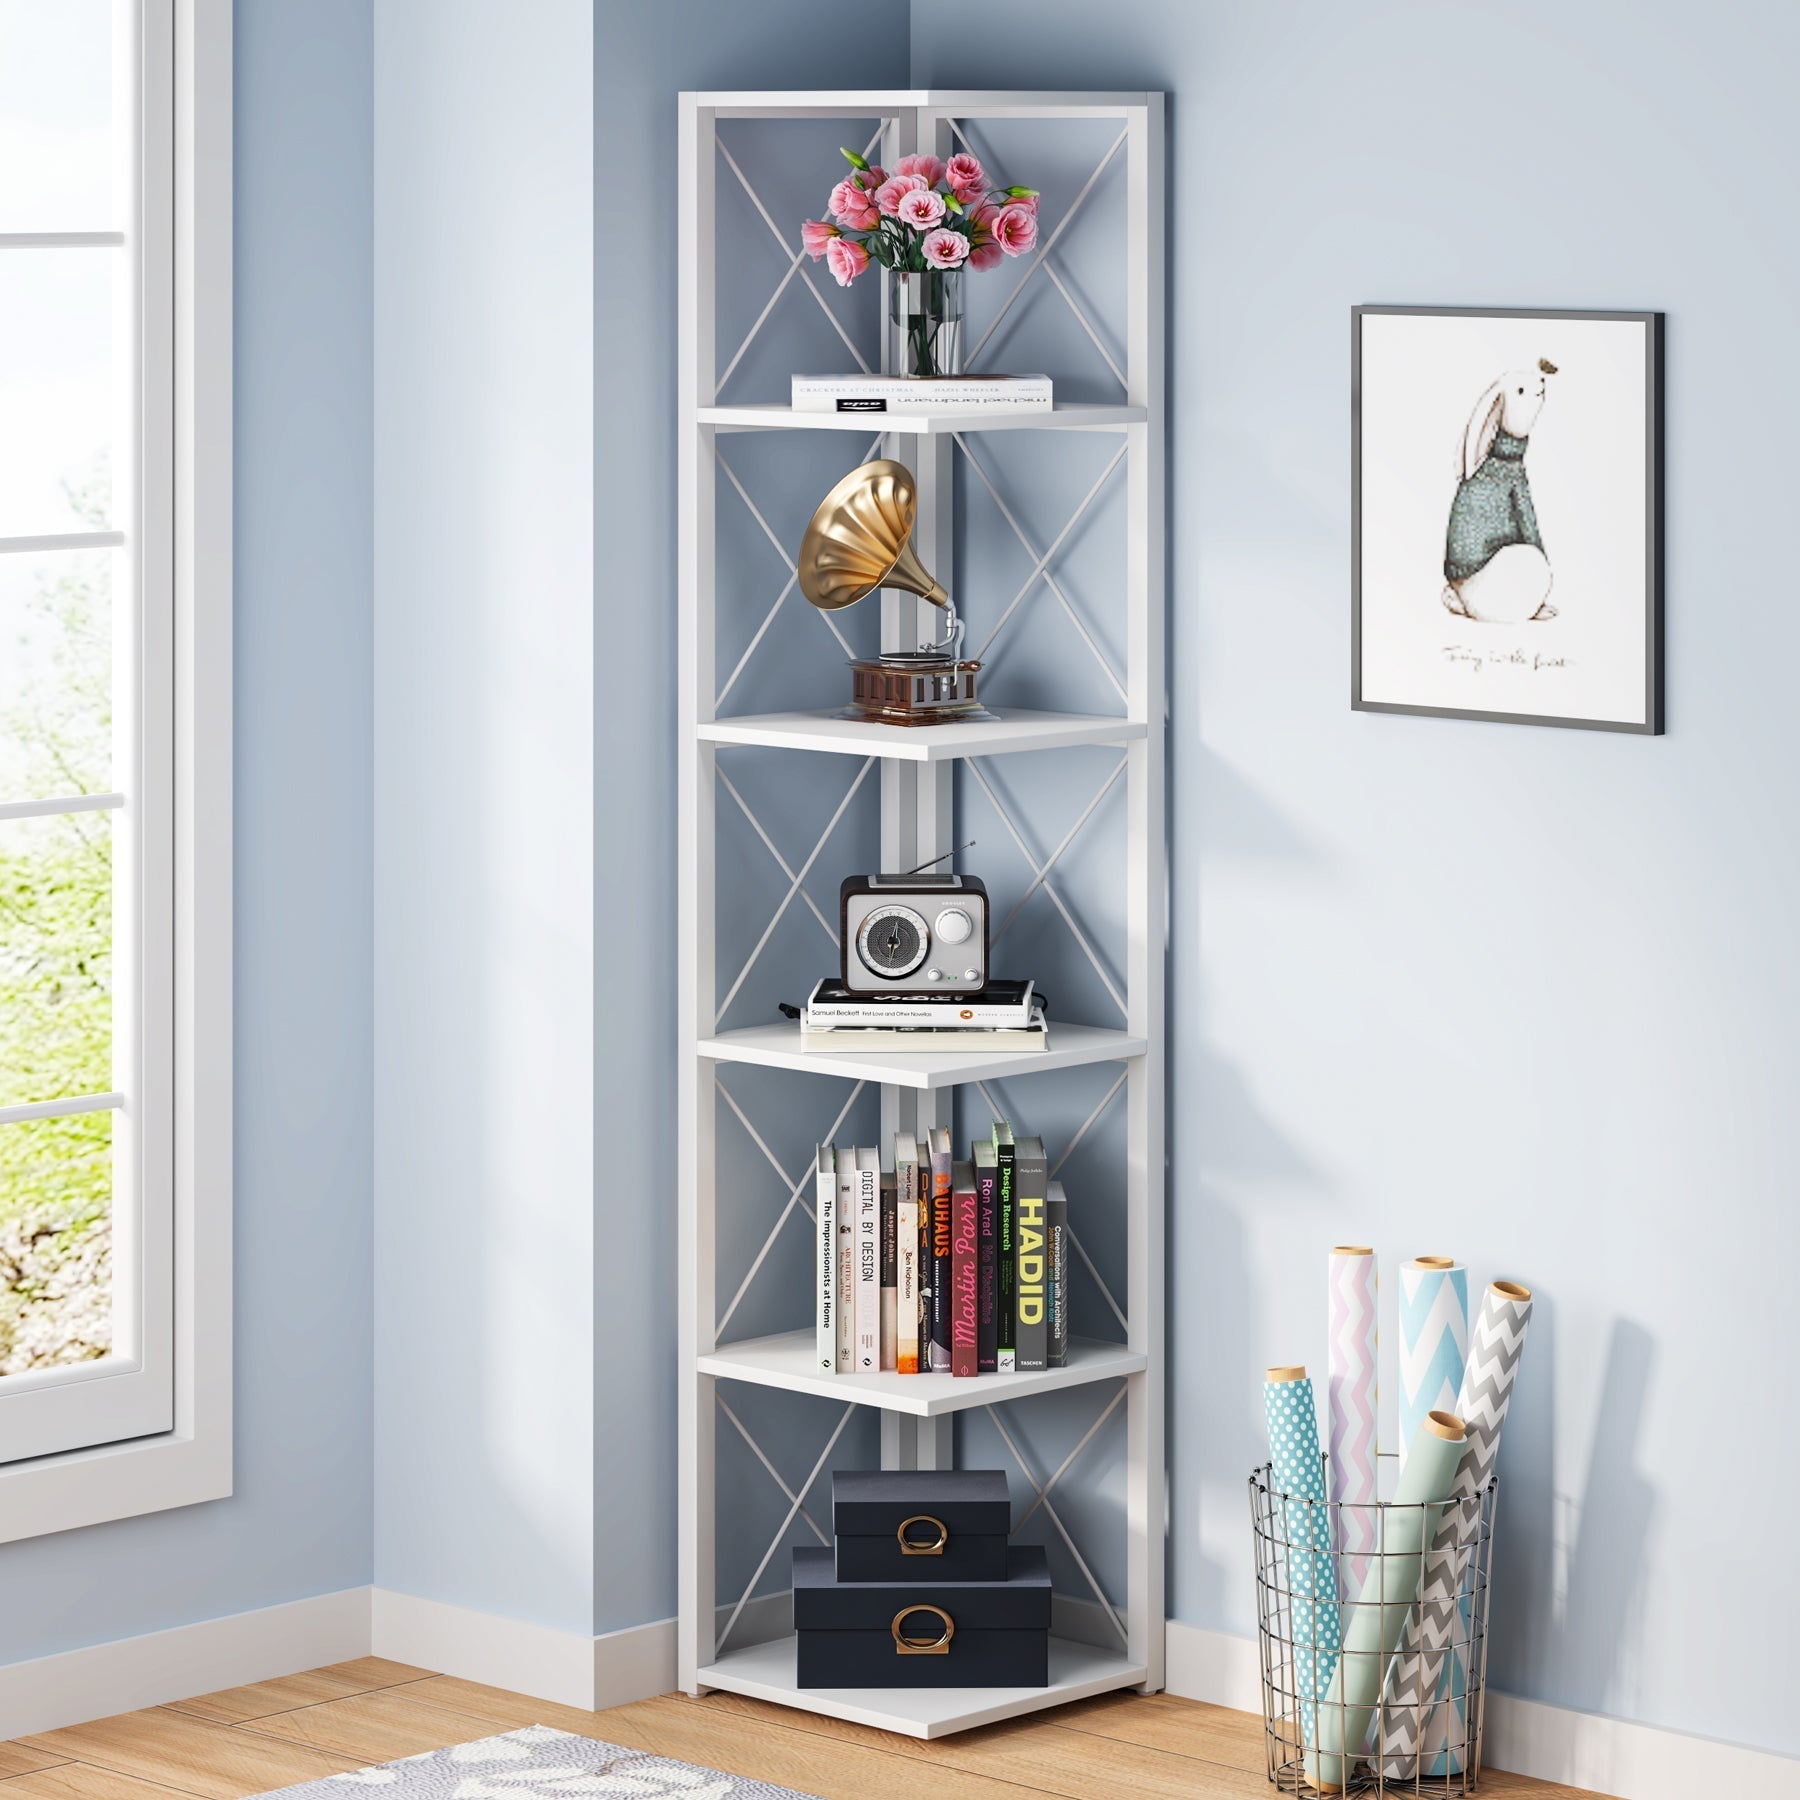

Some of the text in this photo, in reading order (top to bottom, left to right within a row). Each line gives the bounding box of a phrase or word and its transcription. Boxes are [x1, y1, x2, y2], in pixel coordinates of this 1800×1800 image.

[824, 1201, 832, 1217] The
[934, 1174, 949, 1257] BAUHAUS
[1001, 1168, 1011, 1202] Design
[822, 1220, 832, 1287] Impressionists
[862, 1171, 873, 1282] DIGITAL BY DESIGN
[980, 1179, 993, 1324] Ron Arad No Discipline
[1002, 1205, 1011, 1251] Research
[1019, 1198, 1044, 1325] HADID
[824, 1290, 831, 1299] at
[955, 1196, 975, 1343] Martin Parr
